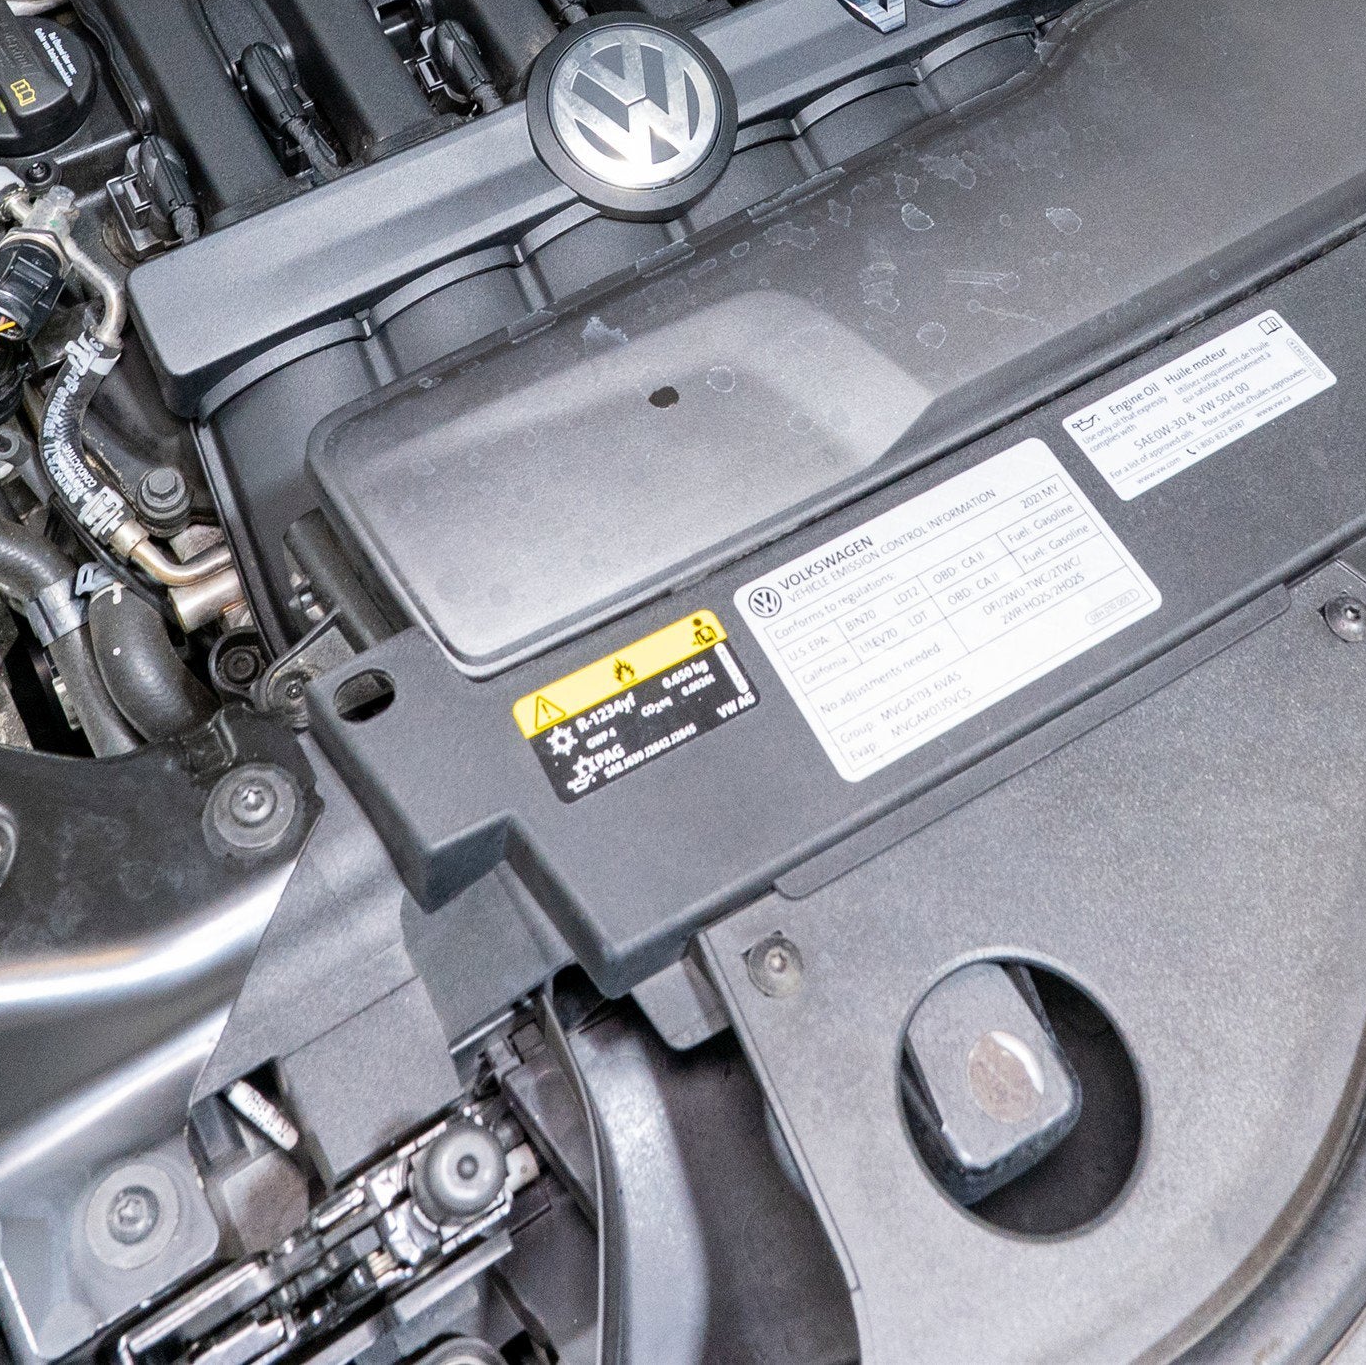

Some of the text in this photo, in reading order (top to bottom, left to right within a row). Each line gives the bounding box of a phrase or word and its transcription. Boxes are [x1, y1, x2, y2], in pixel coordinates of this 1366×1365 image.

[1108, 347, 1227, 415] Engine Oil Huile moteur
[1185, 411, 1196, 421] &
[1196, 399, 1216, 414] VW
[1215, 389, 1235, 405] 504
[1234, 382, 1249, 394] 00
[62, 442, 98, 489] CONDUCTIVE
[1020, 483, 1058, 508] 2021 MY
[1032, 504, 1073, 529] Gasoline
[787, 489, 996, 602] VEHICLE EMISSION CONTROL INFORMATION
[1048, 524, 1089, 549] Gasoline
[778, 536, 873, 590] VOLKSWAGEN
[960, 555, 977, 568] CA
[975, 551, 984, 560] II
[975, 576, 992, 589] CA
[990, 571, 999, 581] II
[893, 586, 919, 605] LDT2
[773, 609, 824, 639] Conforms
[823, 602, 837, 613] to
[845, 609, 876, 631] BIN70
[907, 610, 927, 626] LDT
[661, 658, 709, 689] 0.650 kg
[820, 701, 837, 714] No
[839, 665, 902, 706] adjustments
[575, 692, 636, 733] R-1234yf
[716, 691, 755, 718] VW AG
[593, 743, 625, 768] PAG
